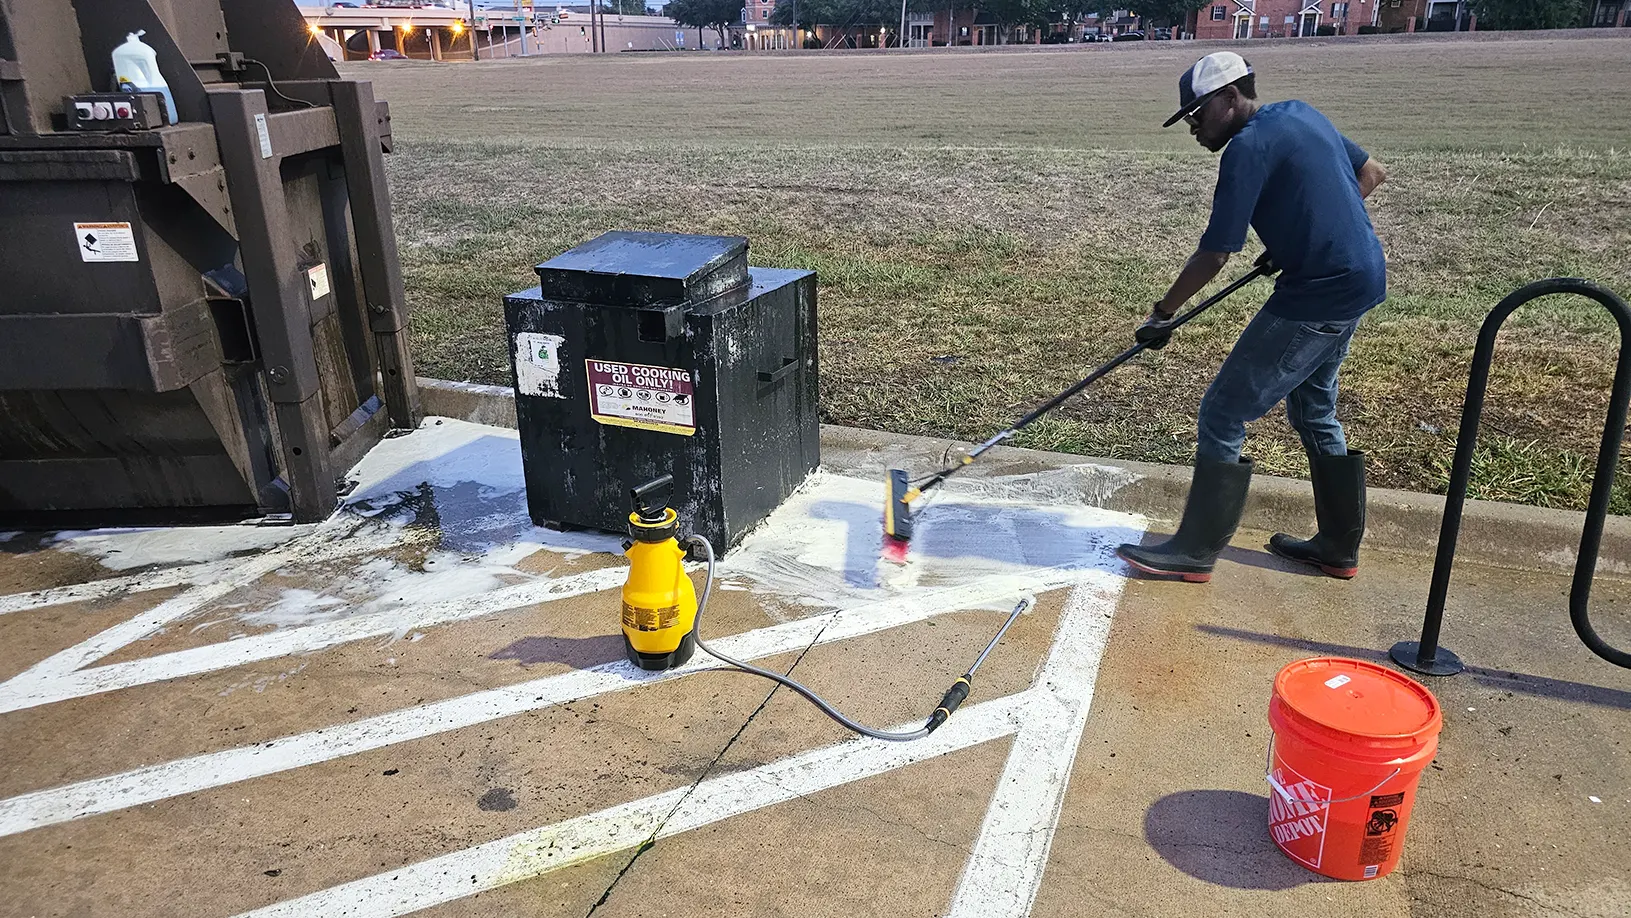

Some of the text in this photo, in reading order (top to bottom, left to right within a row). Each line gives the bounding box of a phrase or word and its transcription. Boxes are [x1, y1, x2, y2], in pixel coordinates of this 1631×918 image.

[594, 362, 691, 382] USED COOKING
[612, 373, 632, 384] OIL
[635, 376, 674, 389] ONLY!
[632, 405, 666, 414] MAHONEY
[1274, 815, 1324, 843] DEPOT
